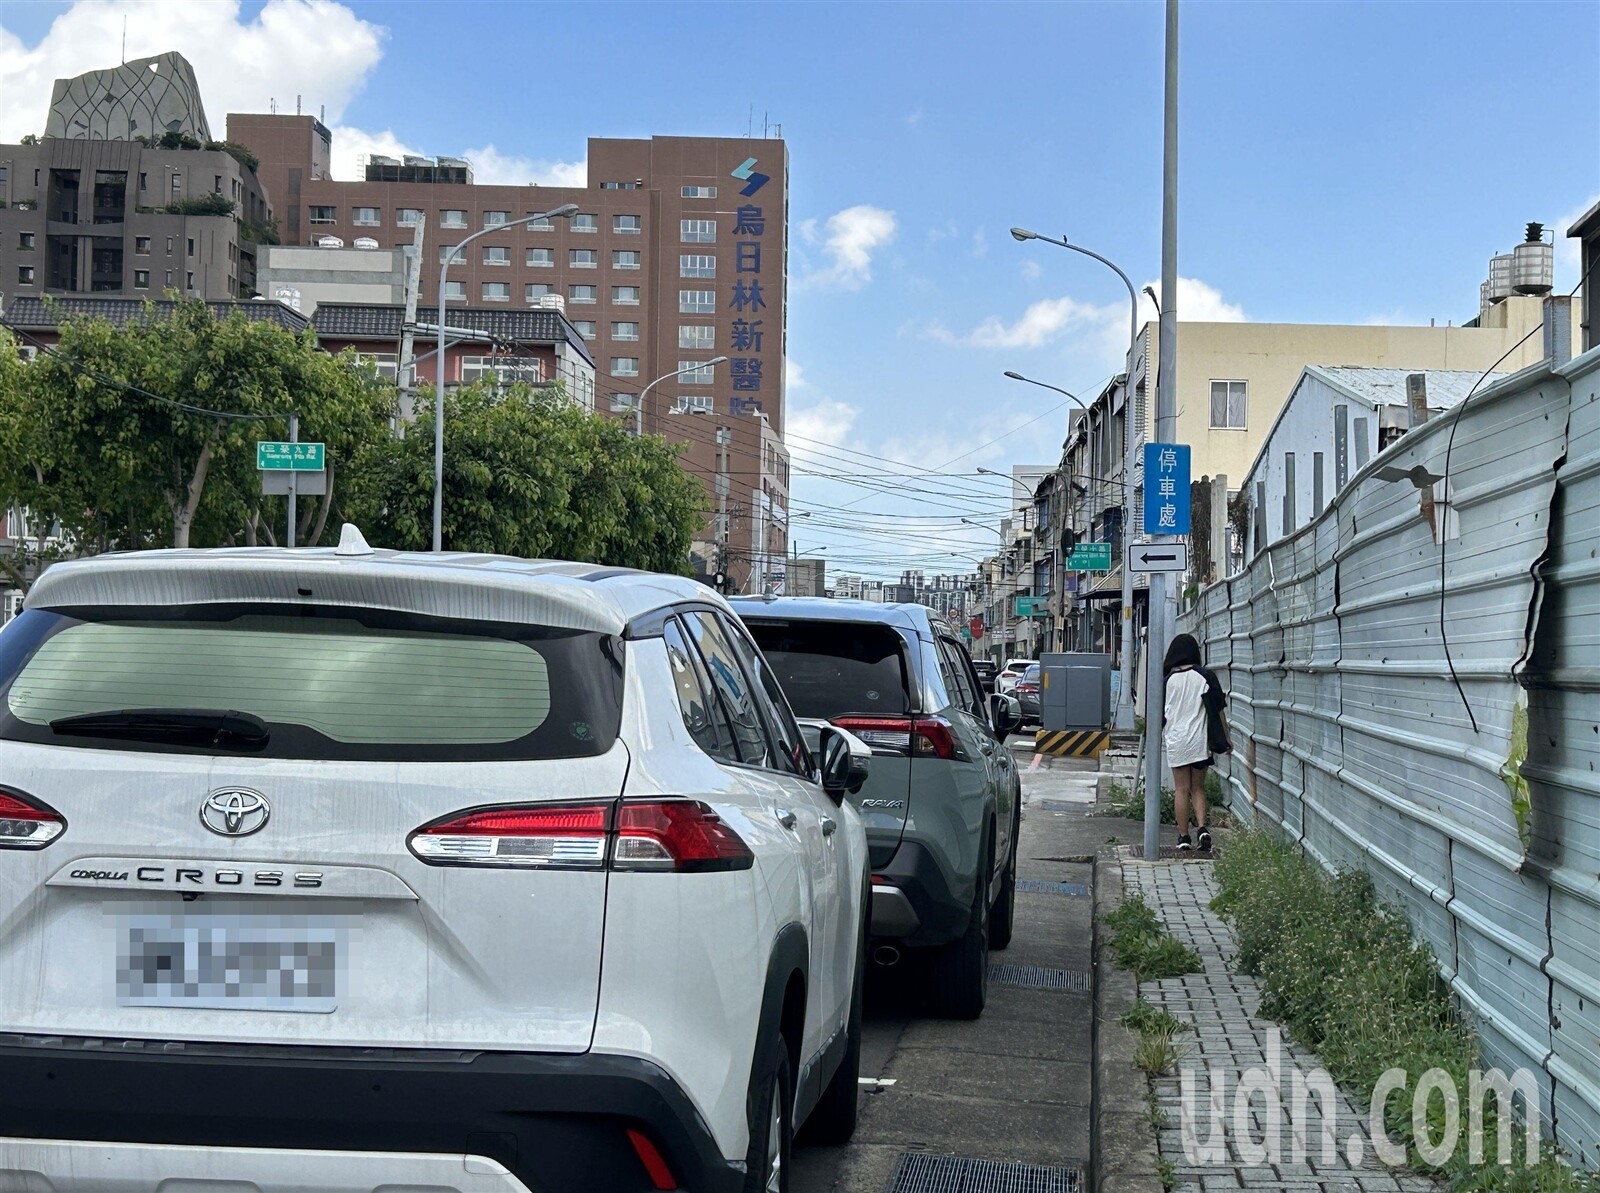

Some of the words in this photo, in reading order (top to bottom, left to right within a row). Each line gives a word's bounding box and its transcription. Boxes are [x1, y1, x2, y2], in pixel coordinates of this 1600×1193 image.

[729, 204, 766, 416] 烏日林新醫院
[1158, 448, 1177, 527] 停車處
[861, 799, 904, 808] RAV4
[70, 869, 129, 881] COROLLA
[136, 867, 324, 888] CROSS
